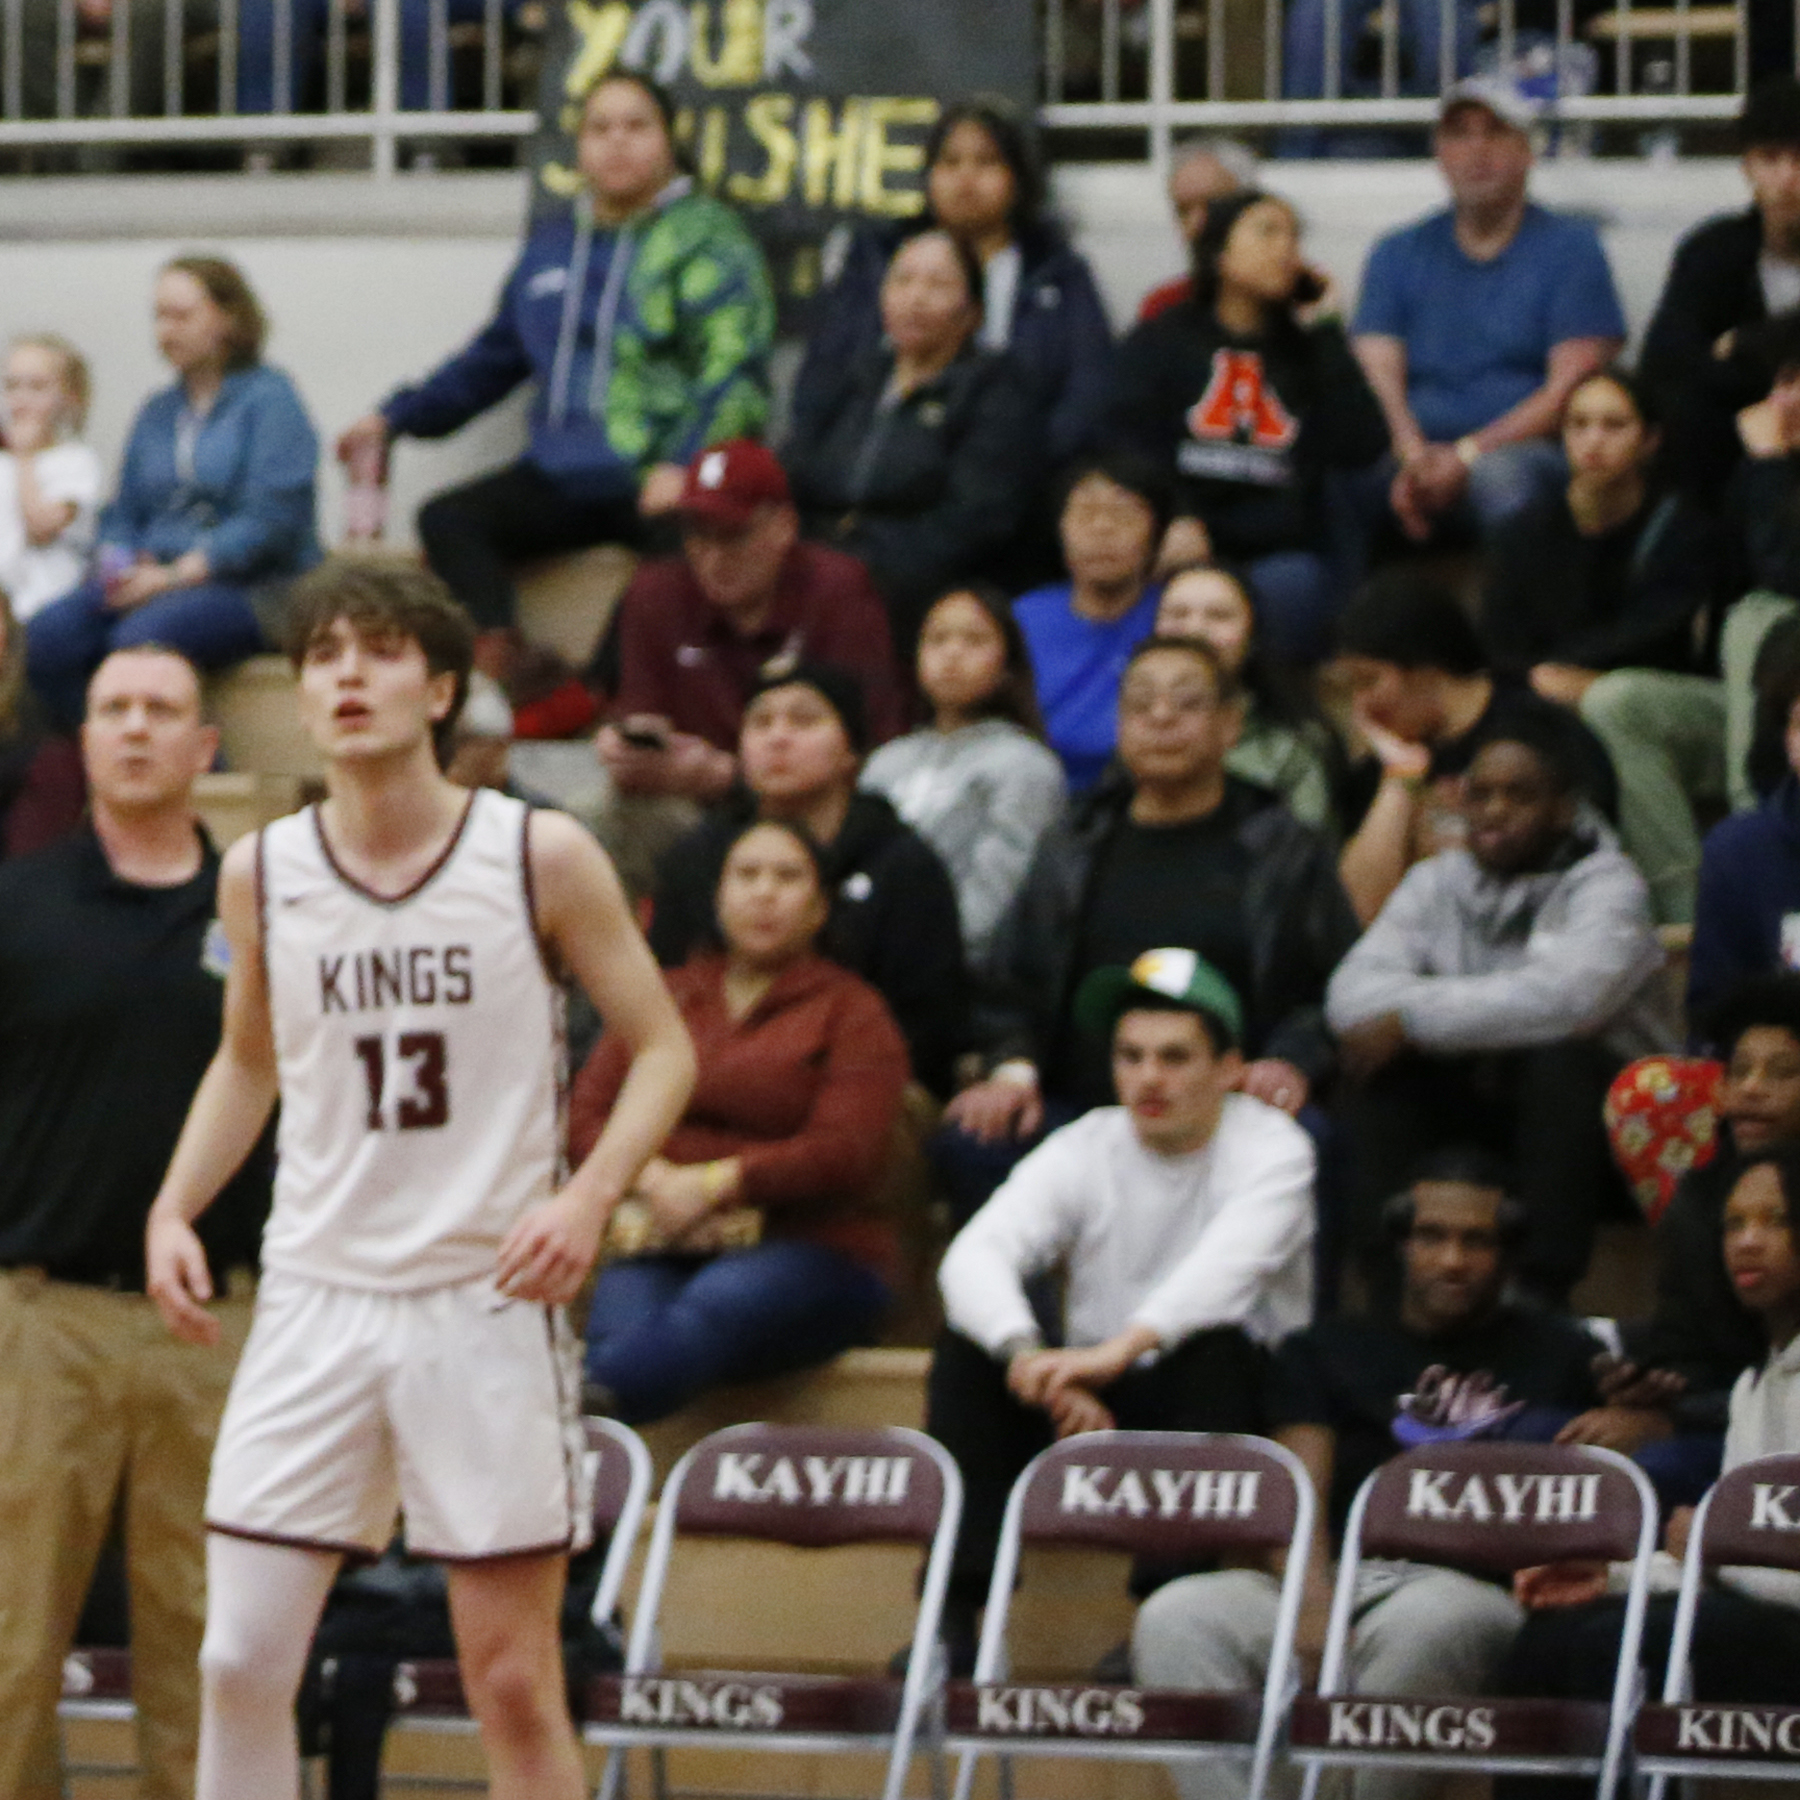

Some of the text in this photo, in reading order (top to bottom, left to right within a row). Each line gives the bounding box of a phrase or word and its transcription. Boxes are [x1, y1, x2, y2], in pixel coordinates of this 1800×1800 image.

[318, 943, 473, 1013] KINGS
[354, 1028, 450, 1131] 13
[713, 1452, 913, 1505] KAYHI
[1060, 1464, 1262, 1519] KAYHI
[1404, 1468, 1603, 1523] KAYHI
[620, 1677, 784, 1727] KINGS
[975, 1686, 1146, 1734] KINGS
[1326, 1700, 1496, 1749] KINGS
[1677, 1708, 1800, 1754] KING
